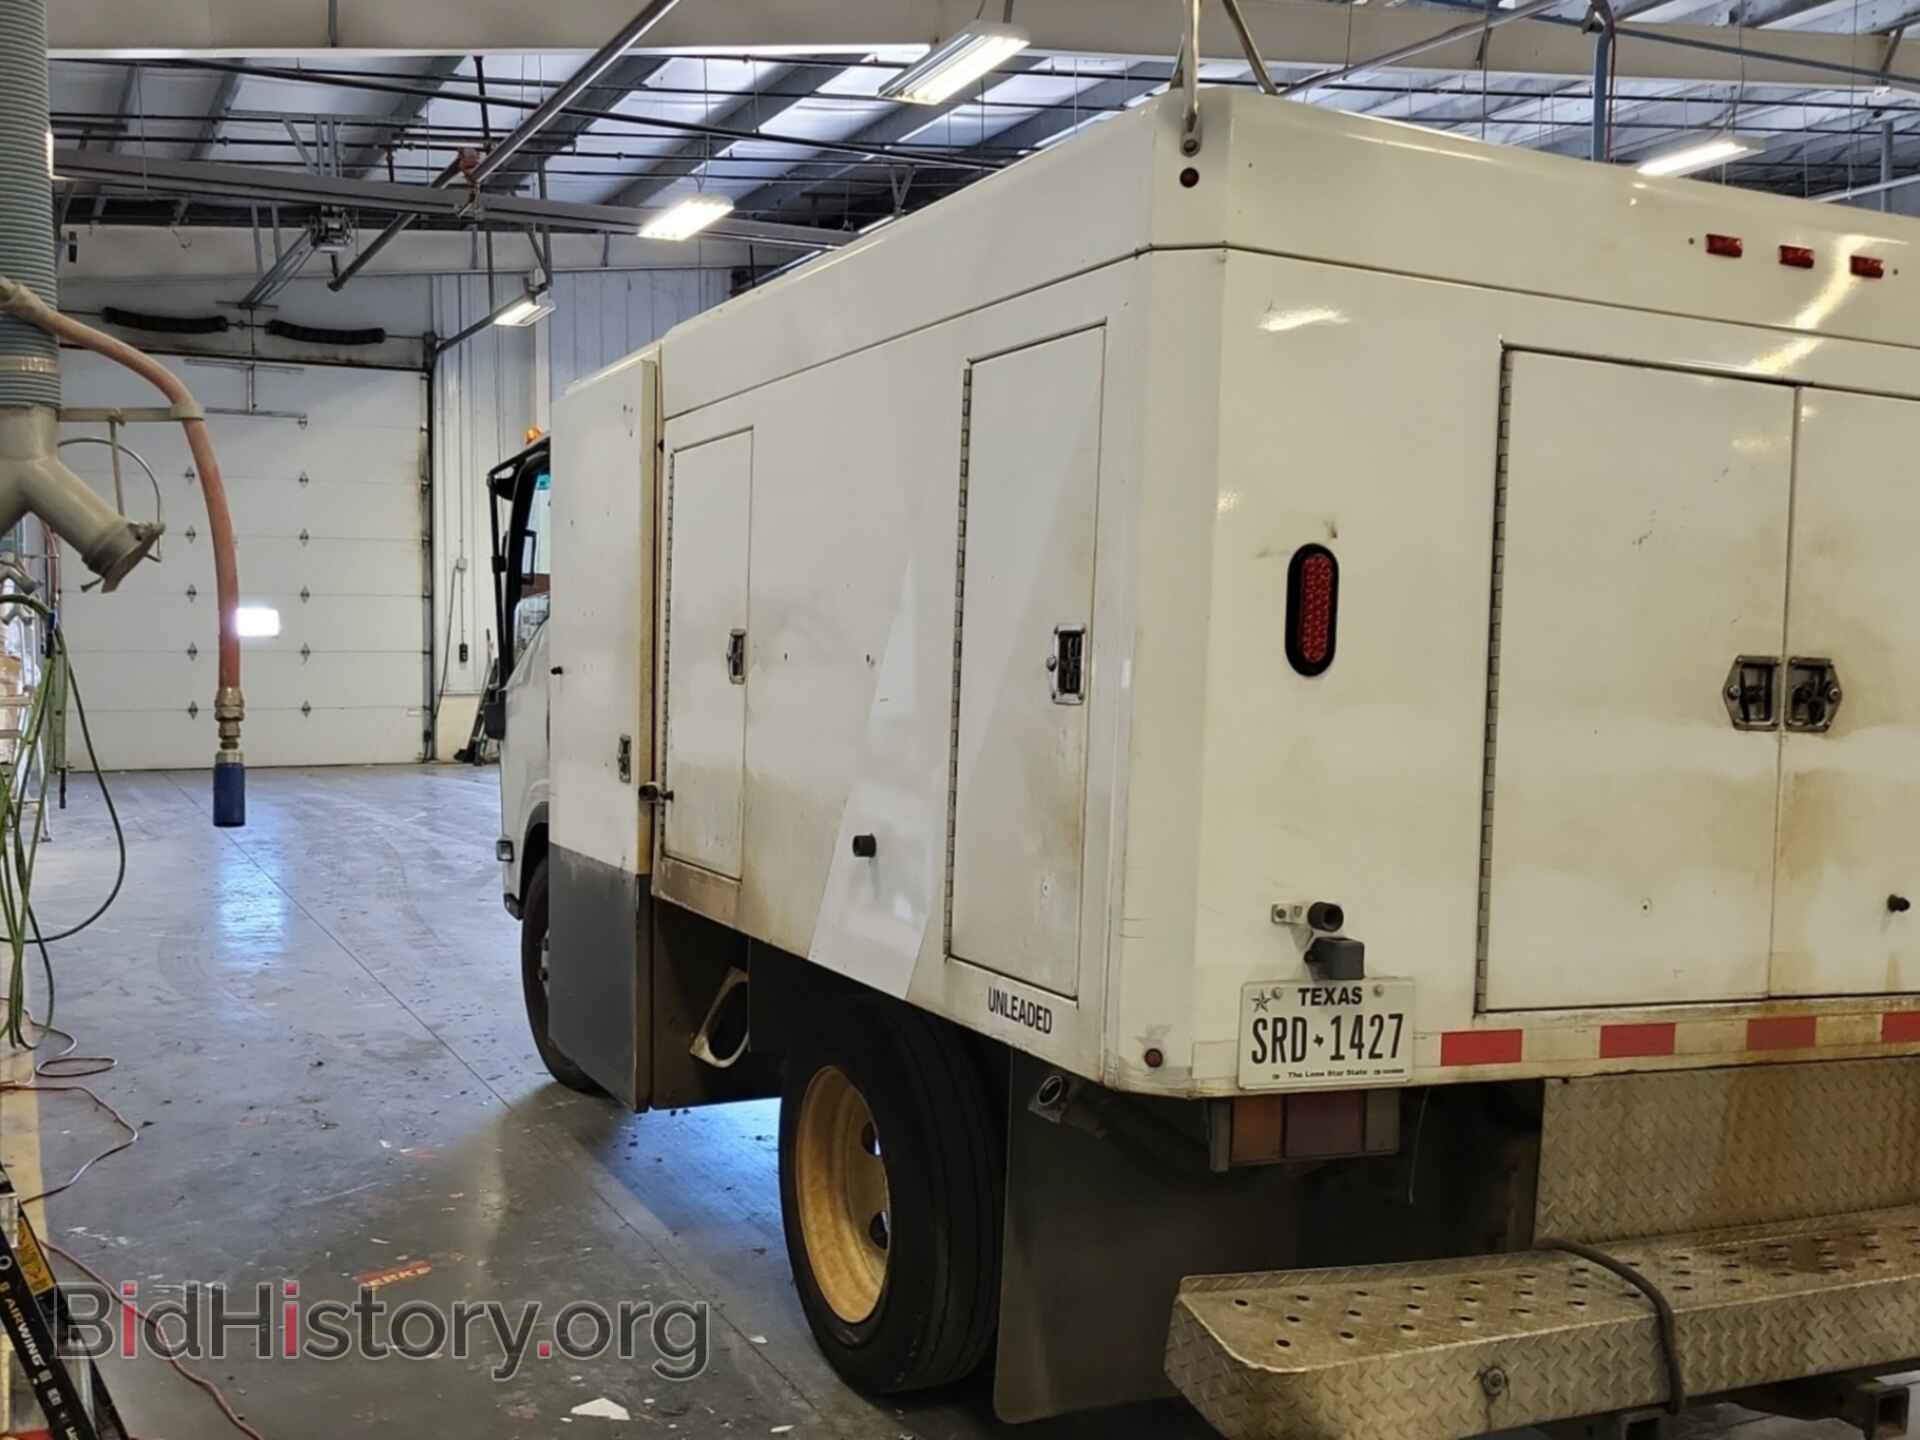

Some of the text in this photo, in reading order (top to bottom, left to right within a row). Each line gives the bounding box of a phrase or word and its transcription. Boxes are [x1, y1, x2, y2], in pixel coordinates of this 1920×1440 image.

[987, 986, 1053, 1035] UNLEADED
[1297, 986, 1363, 1007] TEXAS
[1251, 1013, 1404, 1065] SRD 1427
[1287, 1071, 1303, 1079] The
[1304, 1070, 1325, 1078] Lone
[1326, 1069, 1344, 1077] Star
[1345, 1068, 1368, 1076] State
